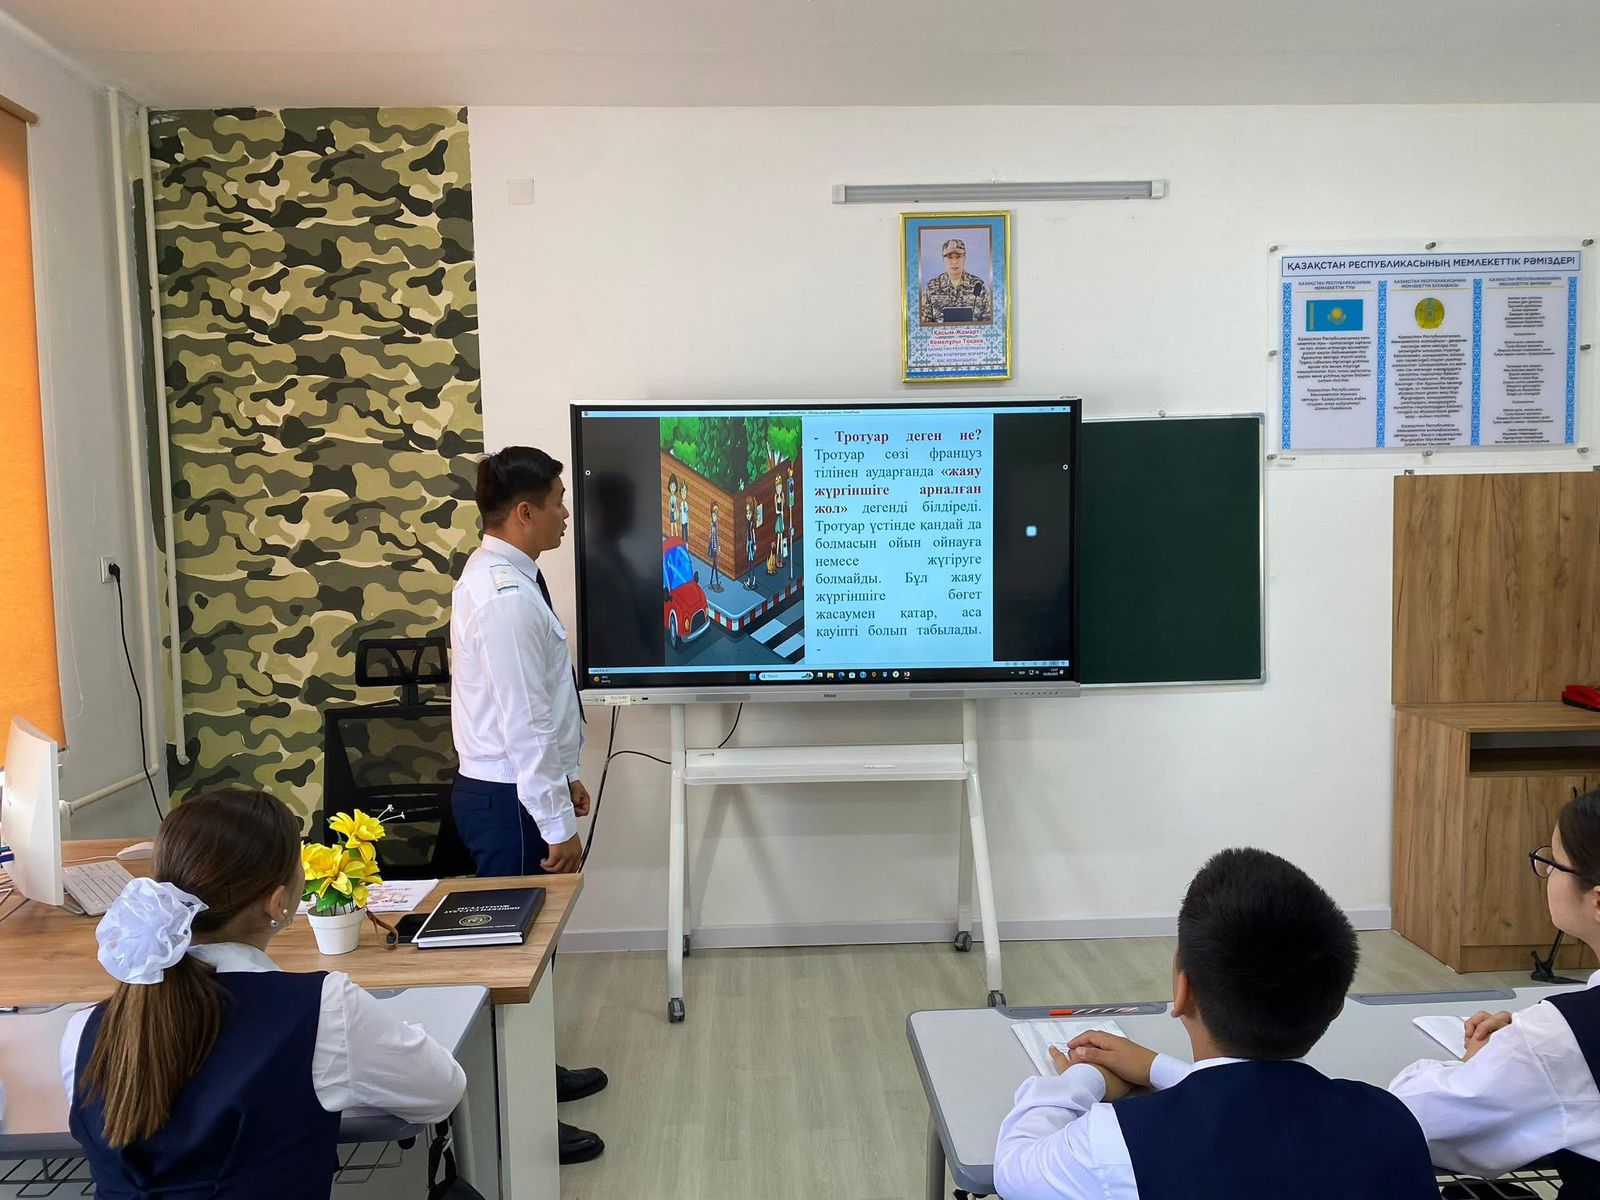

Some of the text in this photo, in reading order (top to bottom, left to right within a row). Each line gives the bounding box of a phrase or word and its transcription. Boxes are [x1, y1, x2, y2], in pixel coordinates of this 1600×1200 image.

[1287, 256, 1576, 271] ҚАЗАҚСТАН РЕСПУБЛИКАСЫНЫҢ МЕМЛЕКЕТТІК РӘМІЗДЕРІ
[835, 430, 889, 445] Тротуар
[906, 431, 942, 443] деген
[960, 428, 982, 442] не?
[814, 447, 982, 463] Тротуар сөзі француз
[814, 466, 982, 481] тілінен аударғанда «жаяу
[814, 484, 982, 499] жүргіншіге арналған
[814, 500, 982, 515] жол» дегенді білдіреді.
[814, 518, 982, 534] Тротуар үстінде қандай да
[815, 536, 982, 550] болмасын ойын ойнауға
[815, 553, 982, 568] немесе жүгіруге
[815, 571, 982, 586] болмайды. Бұл жаяу
[816, 588, 982, 605] жүргіншіге бөгет
[816, 608, 982, 622] жасаумен қатар, аса
[816, 623, 982, 639] қауіпті болып табылады.
